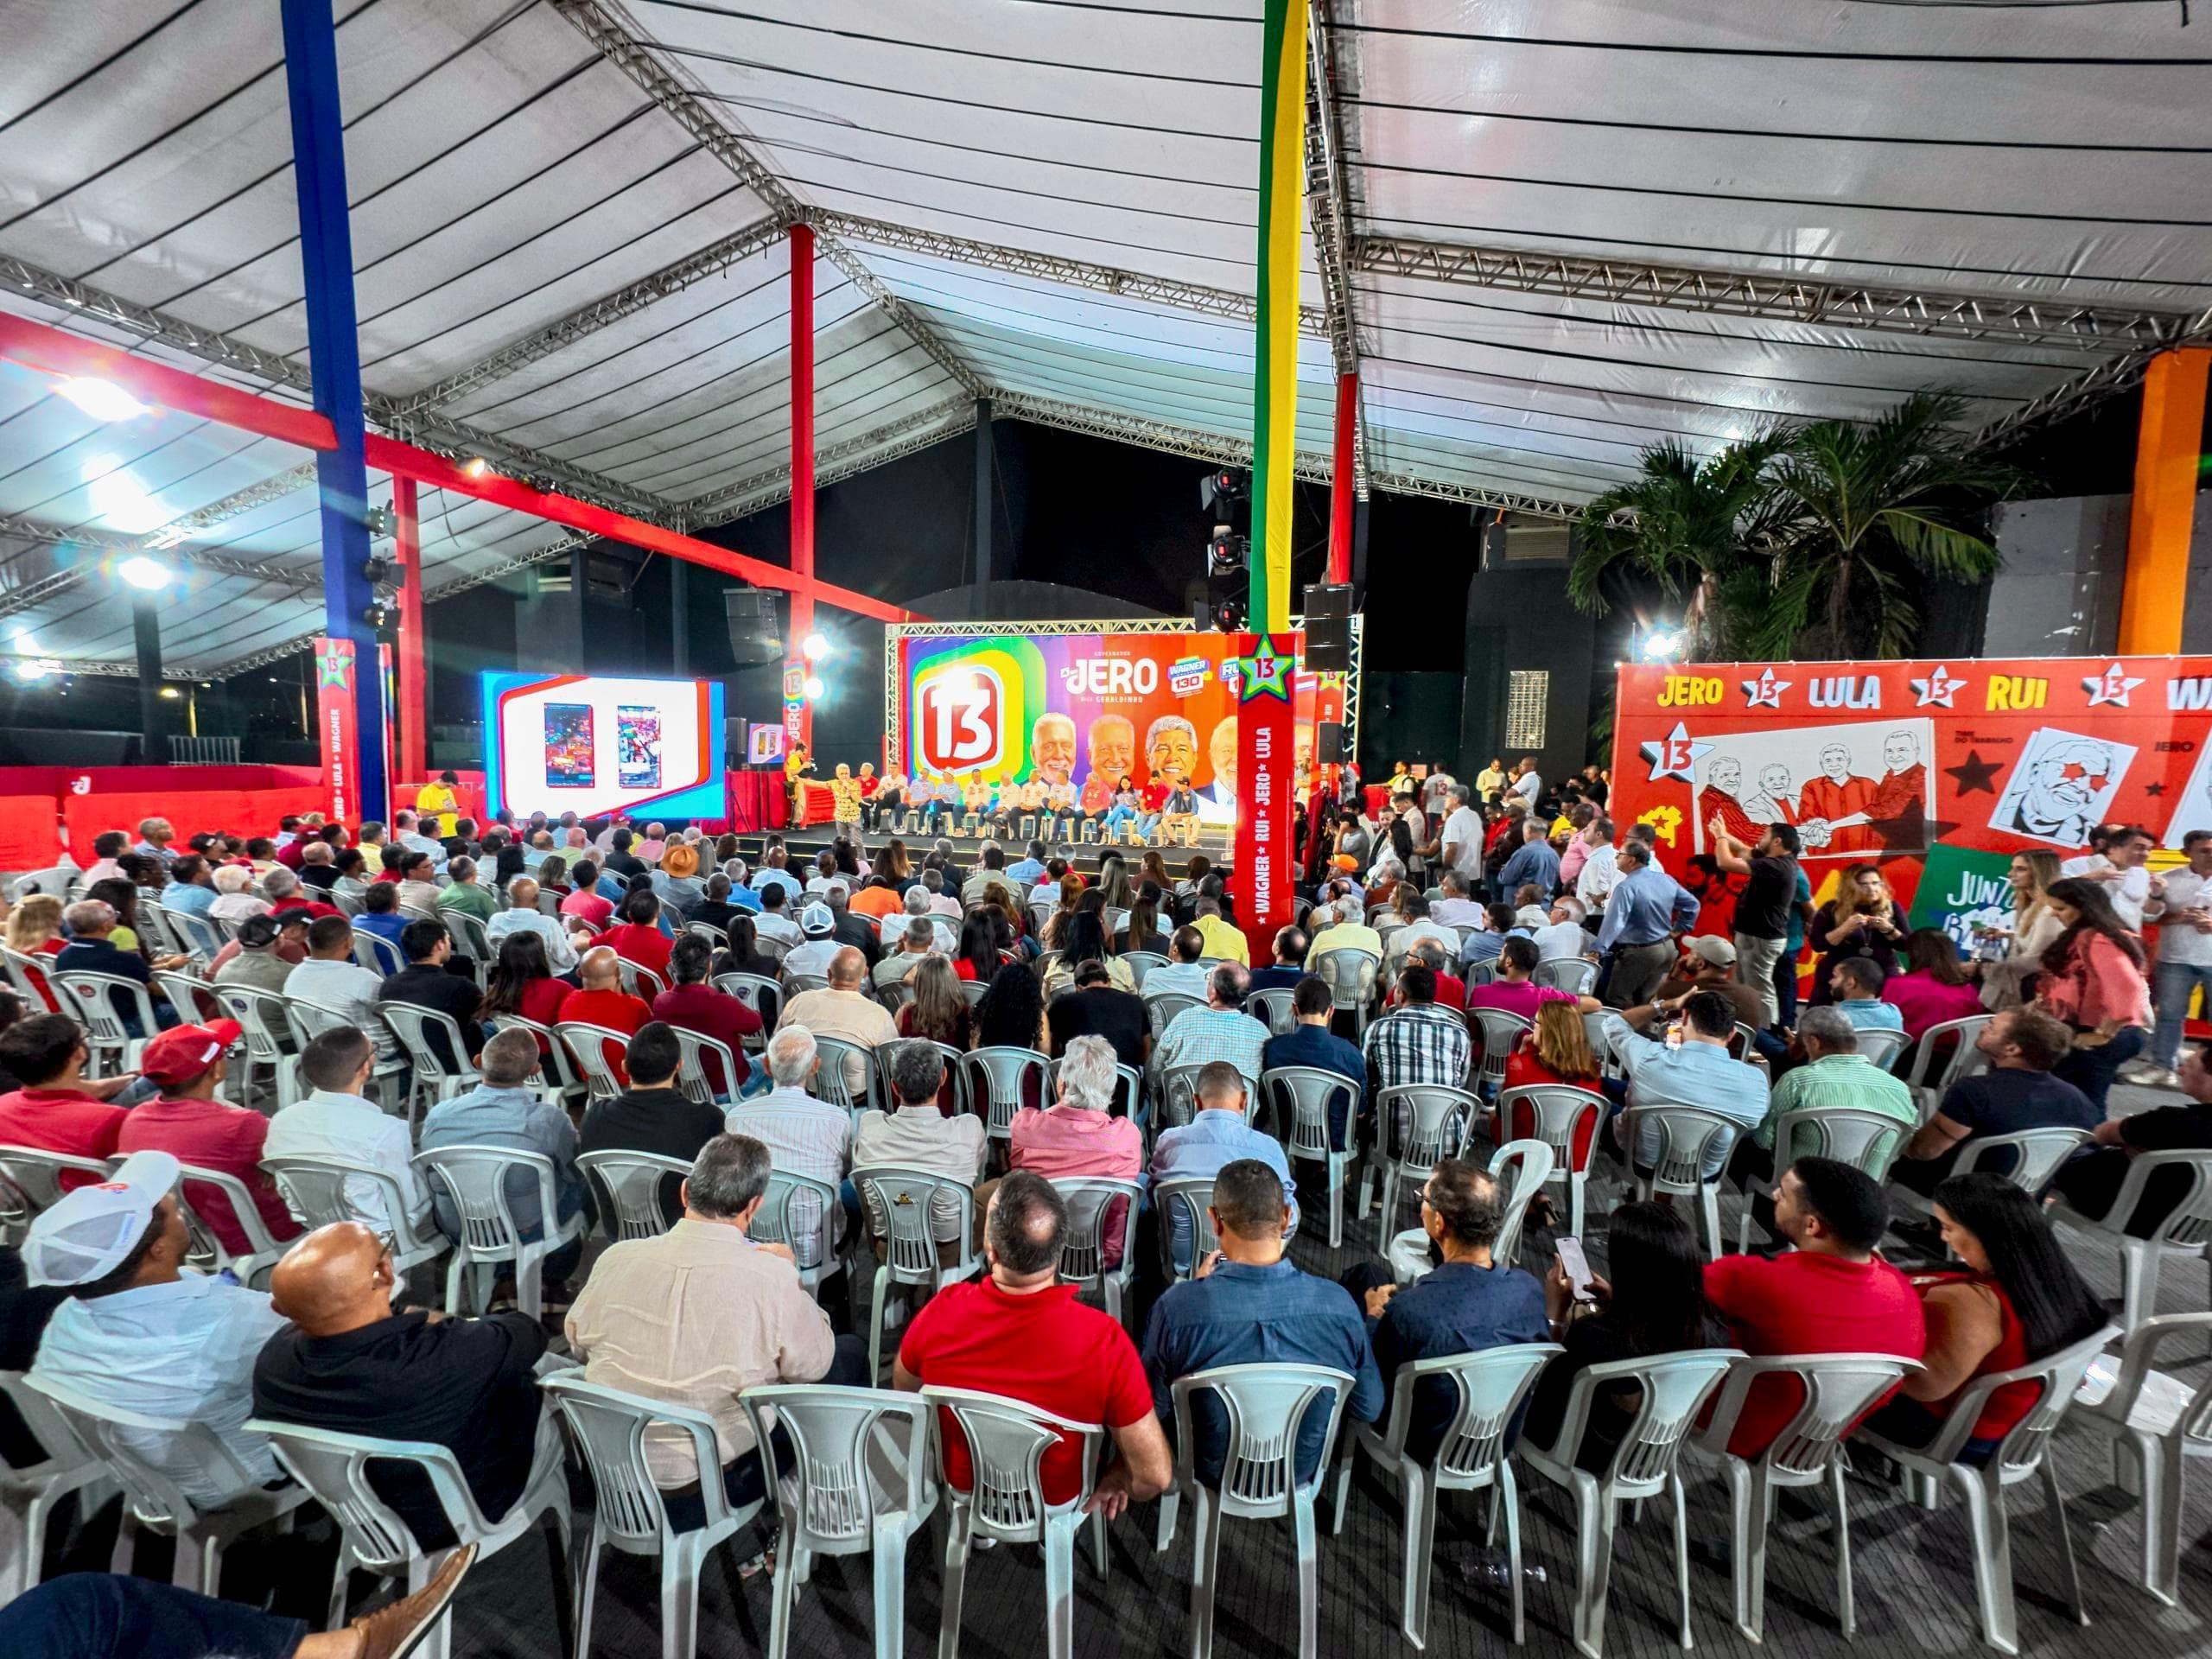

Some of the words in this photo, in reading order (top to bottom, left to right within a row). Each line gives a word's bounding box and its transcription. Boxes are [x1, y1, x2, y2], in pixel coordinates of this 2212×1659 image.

[327, 657, 339, 672] 13
[1065, 658, 1159, 695] JERO
[1169, 659, 1206, 676] WAGNER
[1222, 663, 1239, 676] RU
[1255, 658, 1274, 679] 13
[787, 675, 802, 693] 13
[1175, 676, 1199, 690] 130
[1657, 675, 1724, 708] JERO
[1756, 678, 1777, 701] 13
[1808, 675, 1881, 709] LULA
[1926, 678, 1950, 700] 13
[1986, 675, 2048, 711] RUI
[2100, 676, 2125, 698] 13
[2166, 678, 2212, 710] W
[330, 709, 341, 753] WAGNER
[787, 702, 801, 741] JERO
[931, 686, 994, 760] 13
[1255, 727, 1272, 759] LULA
[1661, 740, 1693, 771] 13
[333, 763, 343, 787] LULA
[1255, 772, 1271, 806] JERO
[1255, 819, 1270, 842] RUI
[1255, 855, 1270, 914] WAGNER
